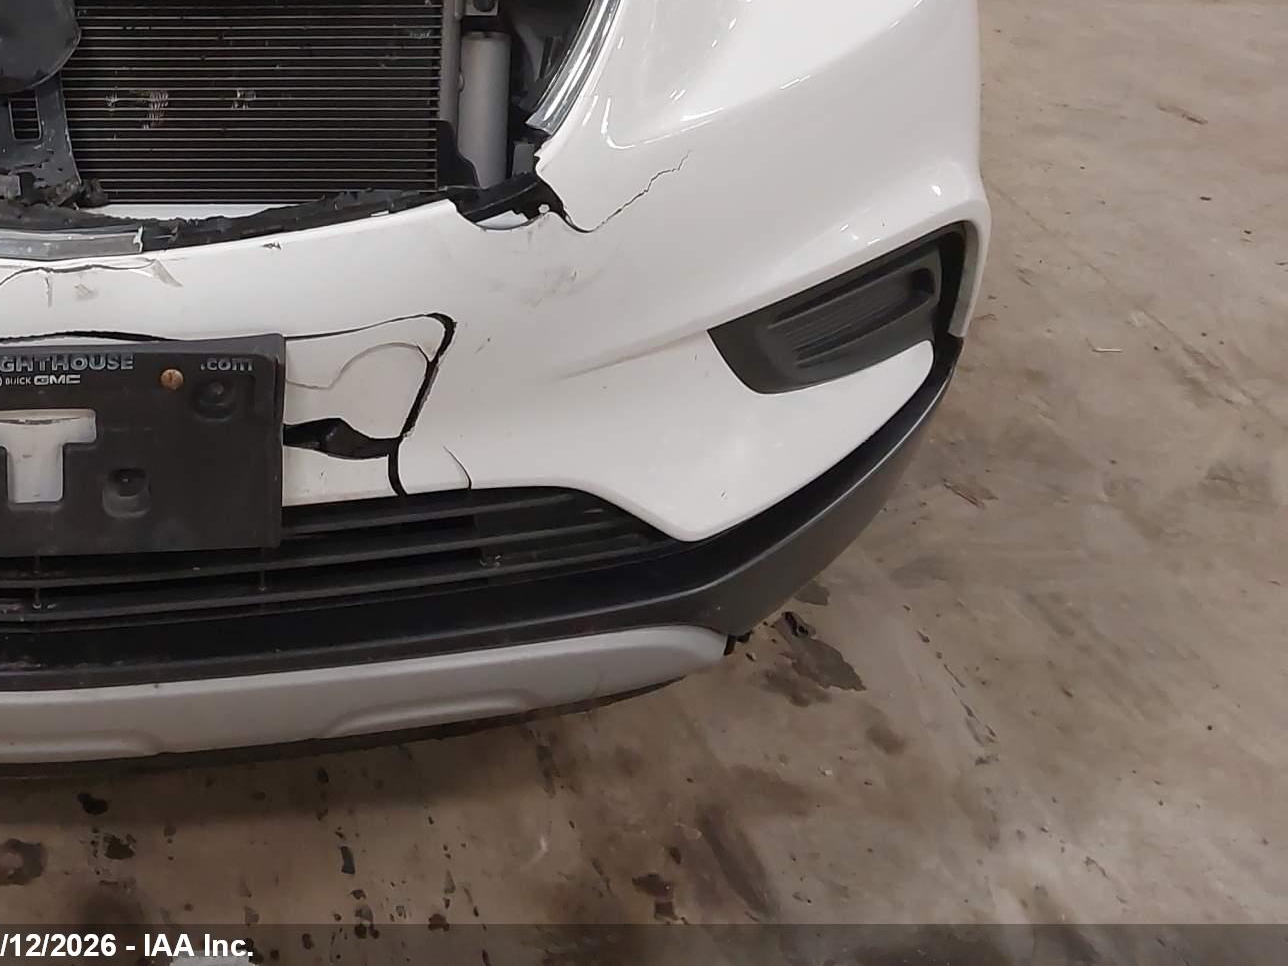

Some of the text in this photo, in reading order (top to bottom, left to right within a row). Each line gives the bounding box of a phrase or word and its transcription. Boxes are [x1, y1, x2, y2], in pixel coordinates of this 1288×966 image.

[199, 357, 253, 371] .com
[5, 374, 81, 386] BUICK GMC
